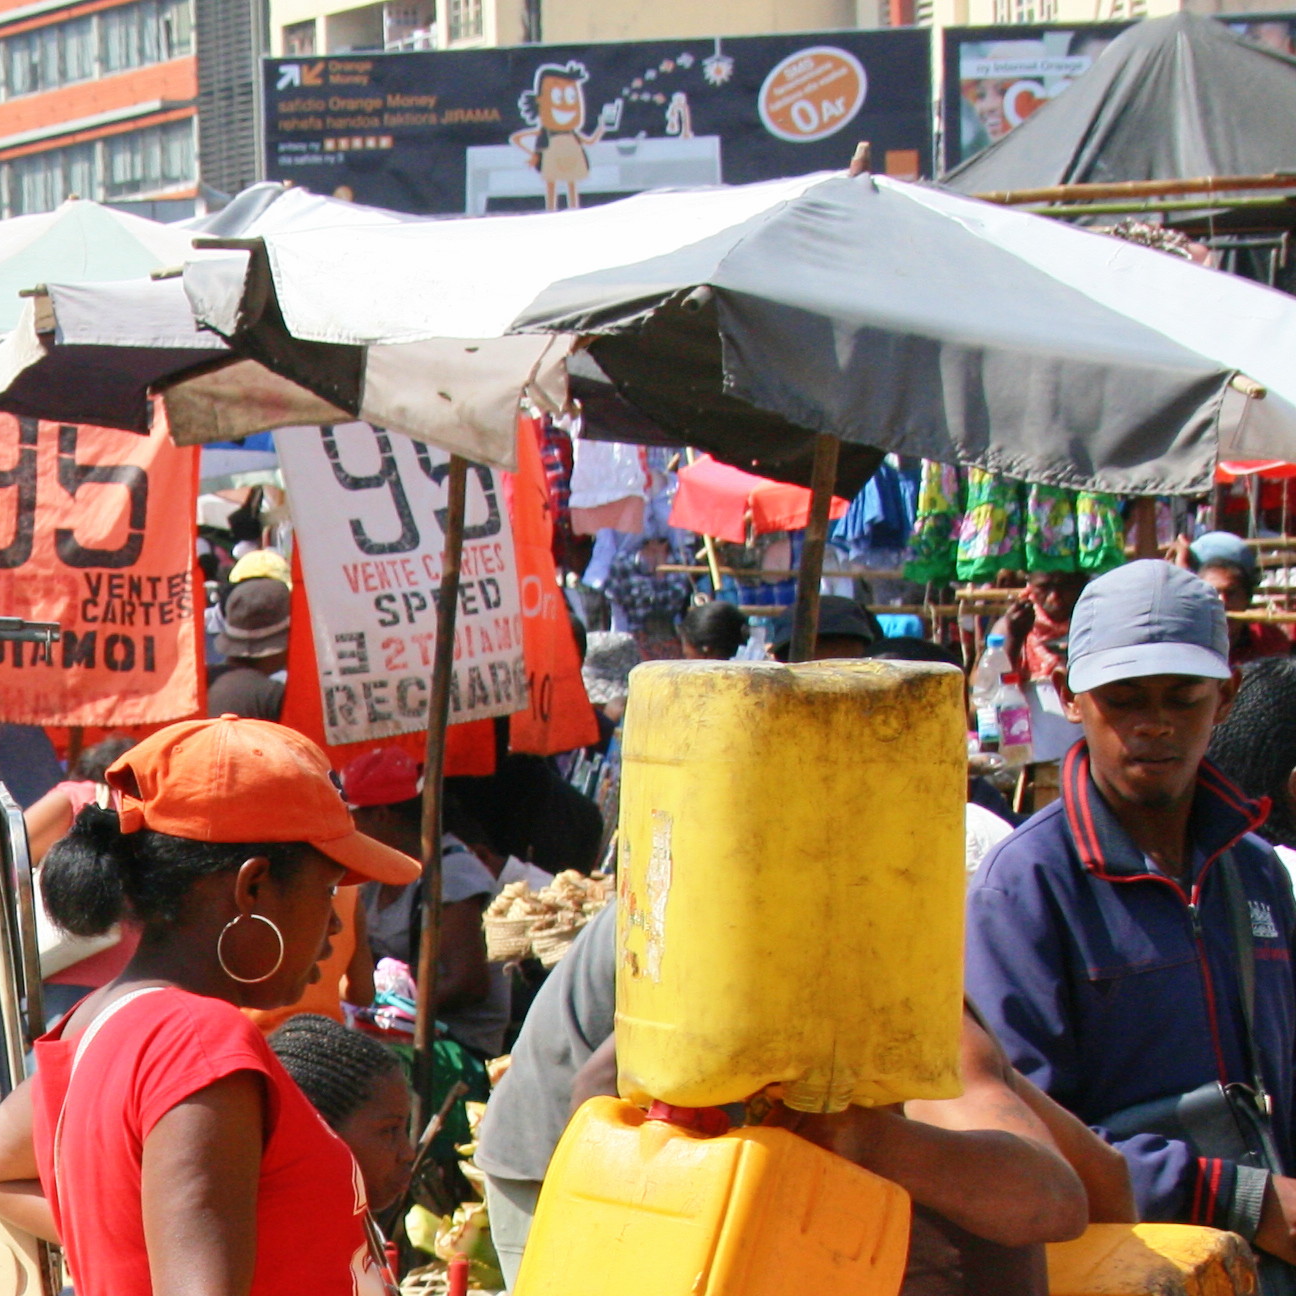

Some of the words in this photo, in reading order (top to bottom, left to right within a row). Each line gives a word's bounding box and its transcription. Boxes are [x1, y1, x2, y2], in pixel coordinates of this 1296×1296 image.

[328, 96, 384, 112] Orange
[386, 93, 438, 109] Money
[441, 107, 502, 125] JIRAMA
[319, 423, 501, 555] 95
[82, 570, 192, 601] VENTES
[343, 558, 415, 594] VENTE
[80, 599, 192, 626] CARTES
[374, 577, 501, 627] SPED
